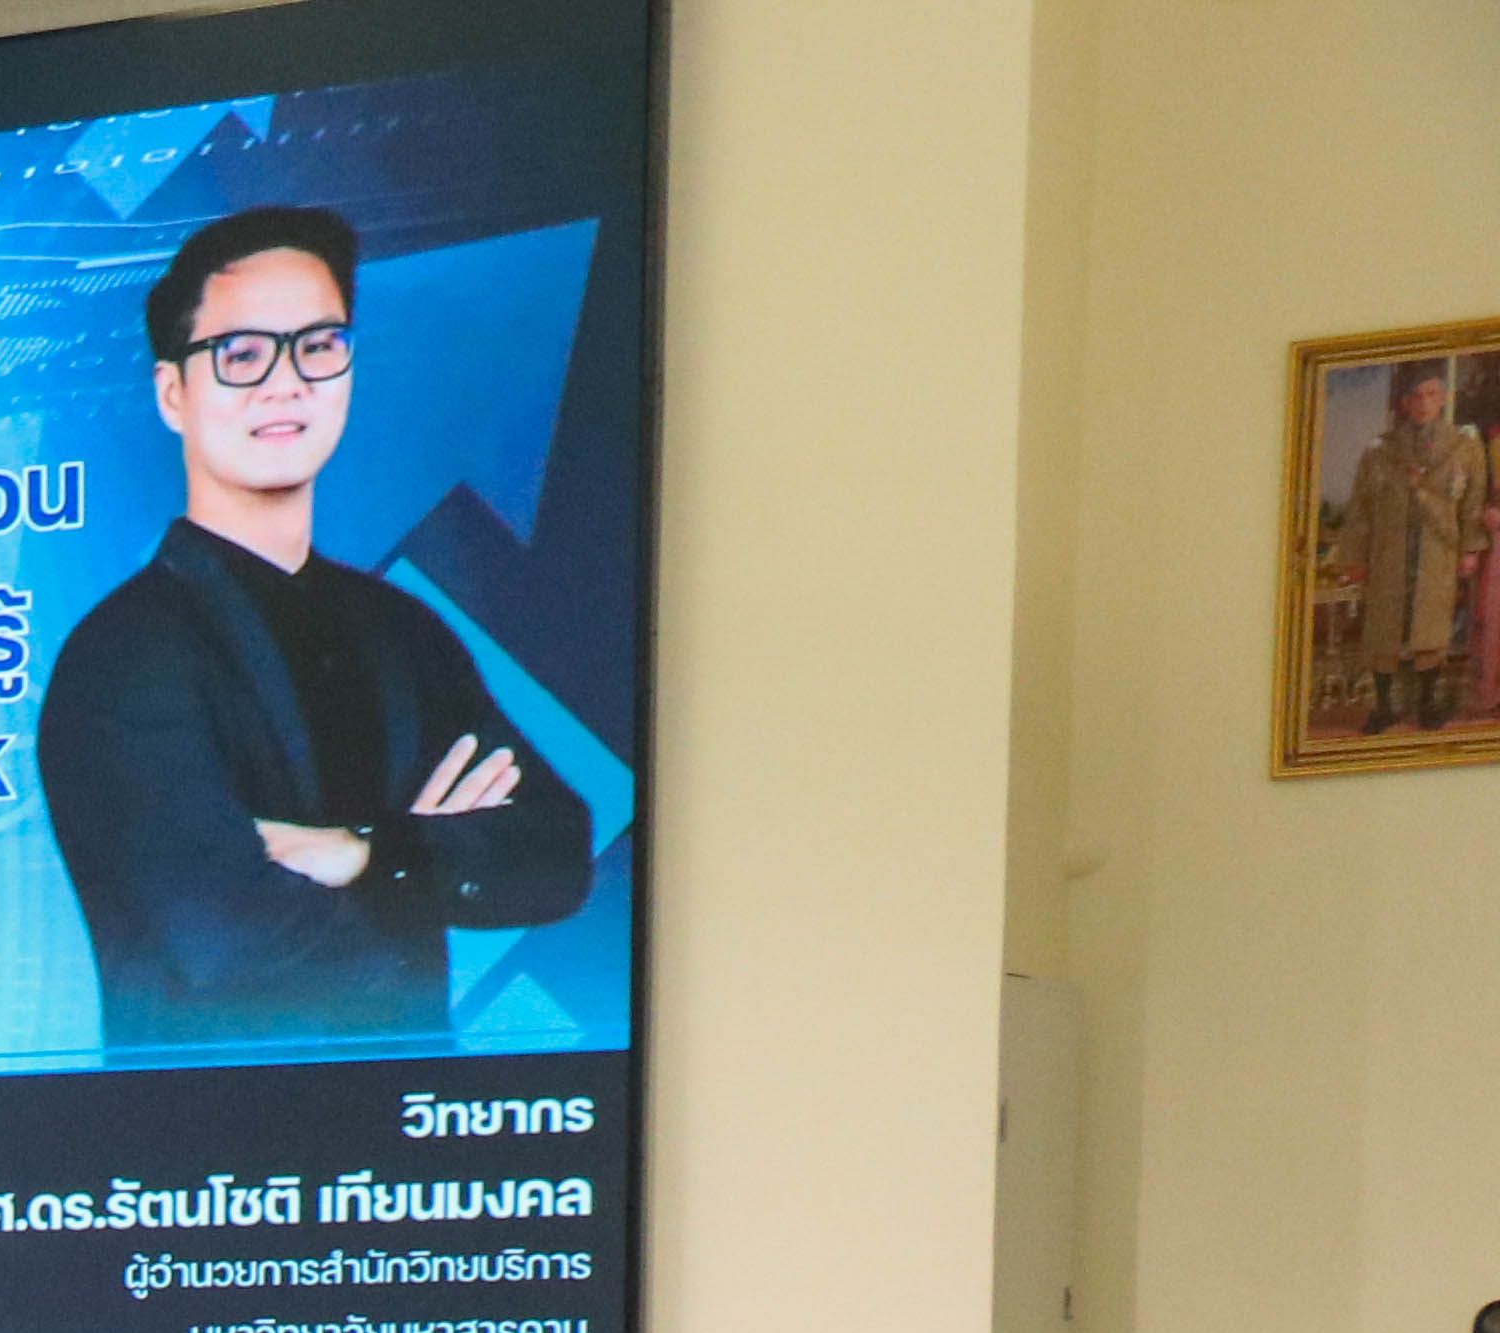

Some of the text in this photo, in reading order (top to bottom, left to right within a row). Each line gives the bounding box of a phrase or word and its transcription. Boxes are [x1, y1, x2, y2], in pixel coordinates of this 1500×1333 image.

[400, 1093, 595, 1140] วิทยากร
[317, 1168, 593, 1225] เทียนมงคล
[124, 1248, 593, 1300] ผู้อำนวยการสำนักวิทยบริการ
